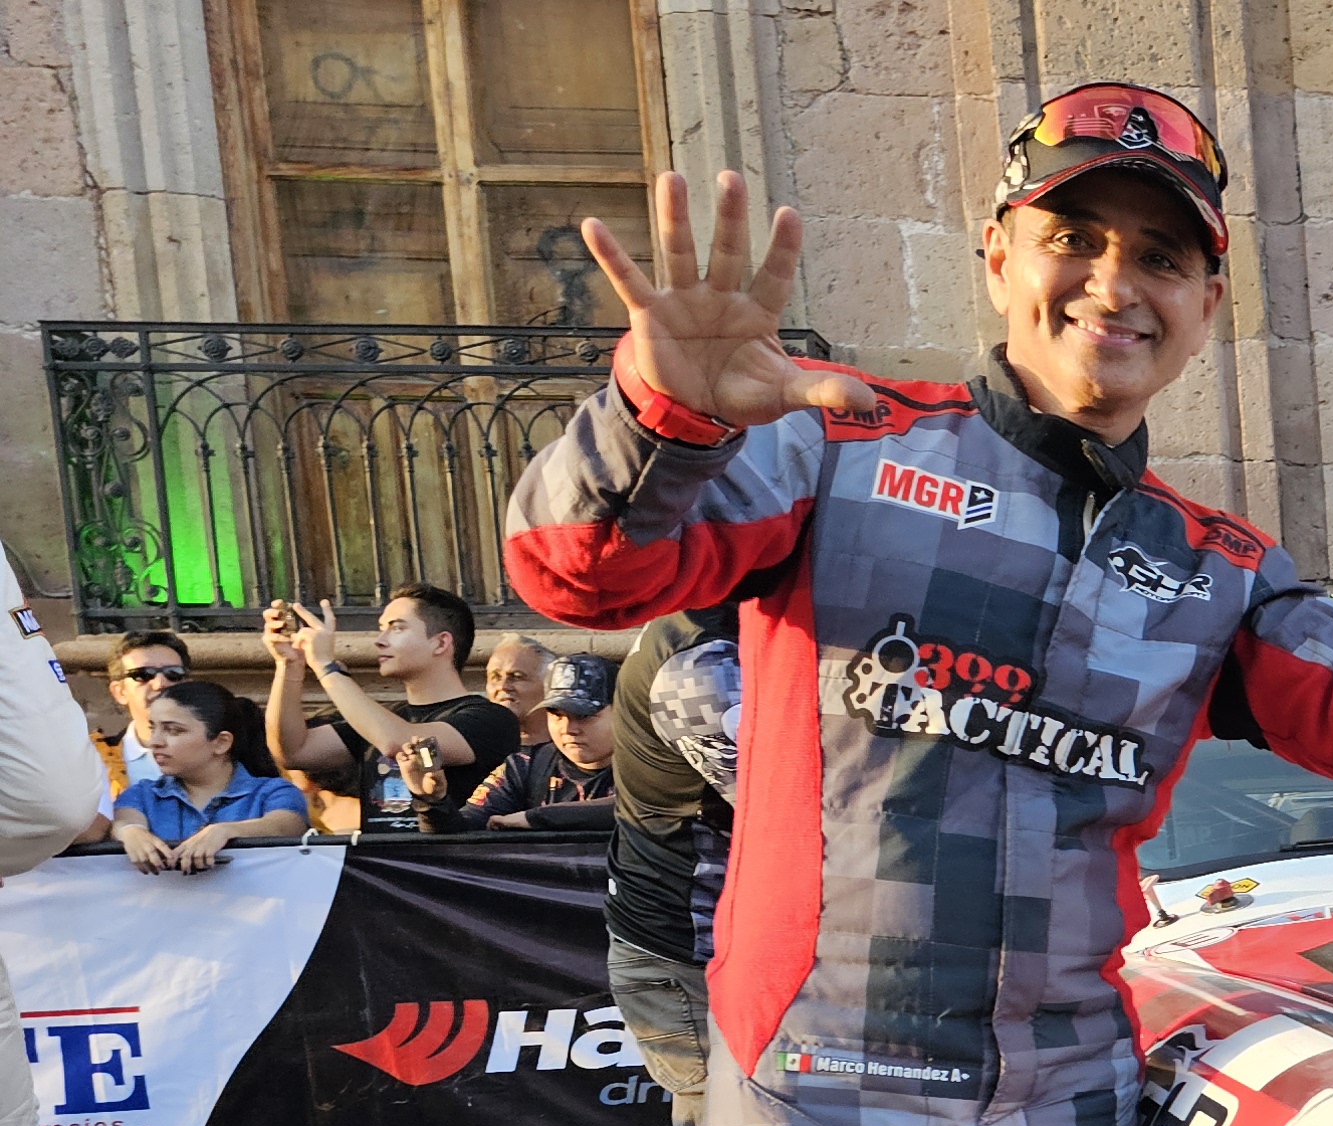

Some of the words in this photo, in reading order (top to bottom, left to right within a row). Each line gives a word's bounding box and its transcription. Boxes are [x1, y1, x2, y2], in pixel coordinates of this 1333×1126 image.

[877, 463, 965, 517] MGR
[871, 682, 1150, 787] TACTICAL
[484, 1005, 648, 1075] Ha
[816, 1056, 866, 1075] Marco
[867, 1061, 950, 1083] Hernandez
